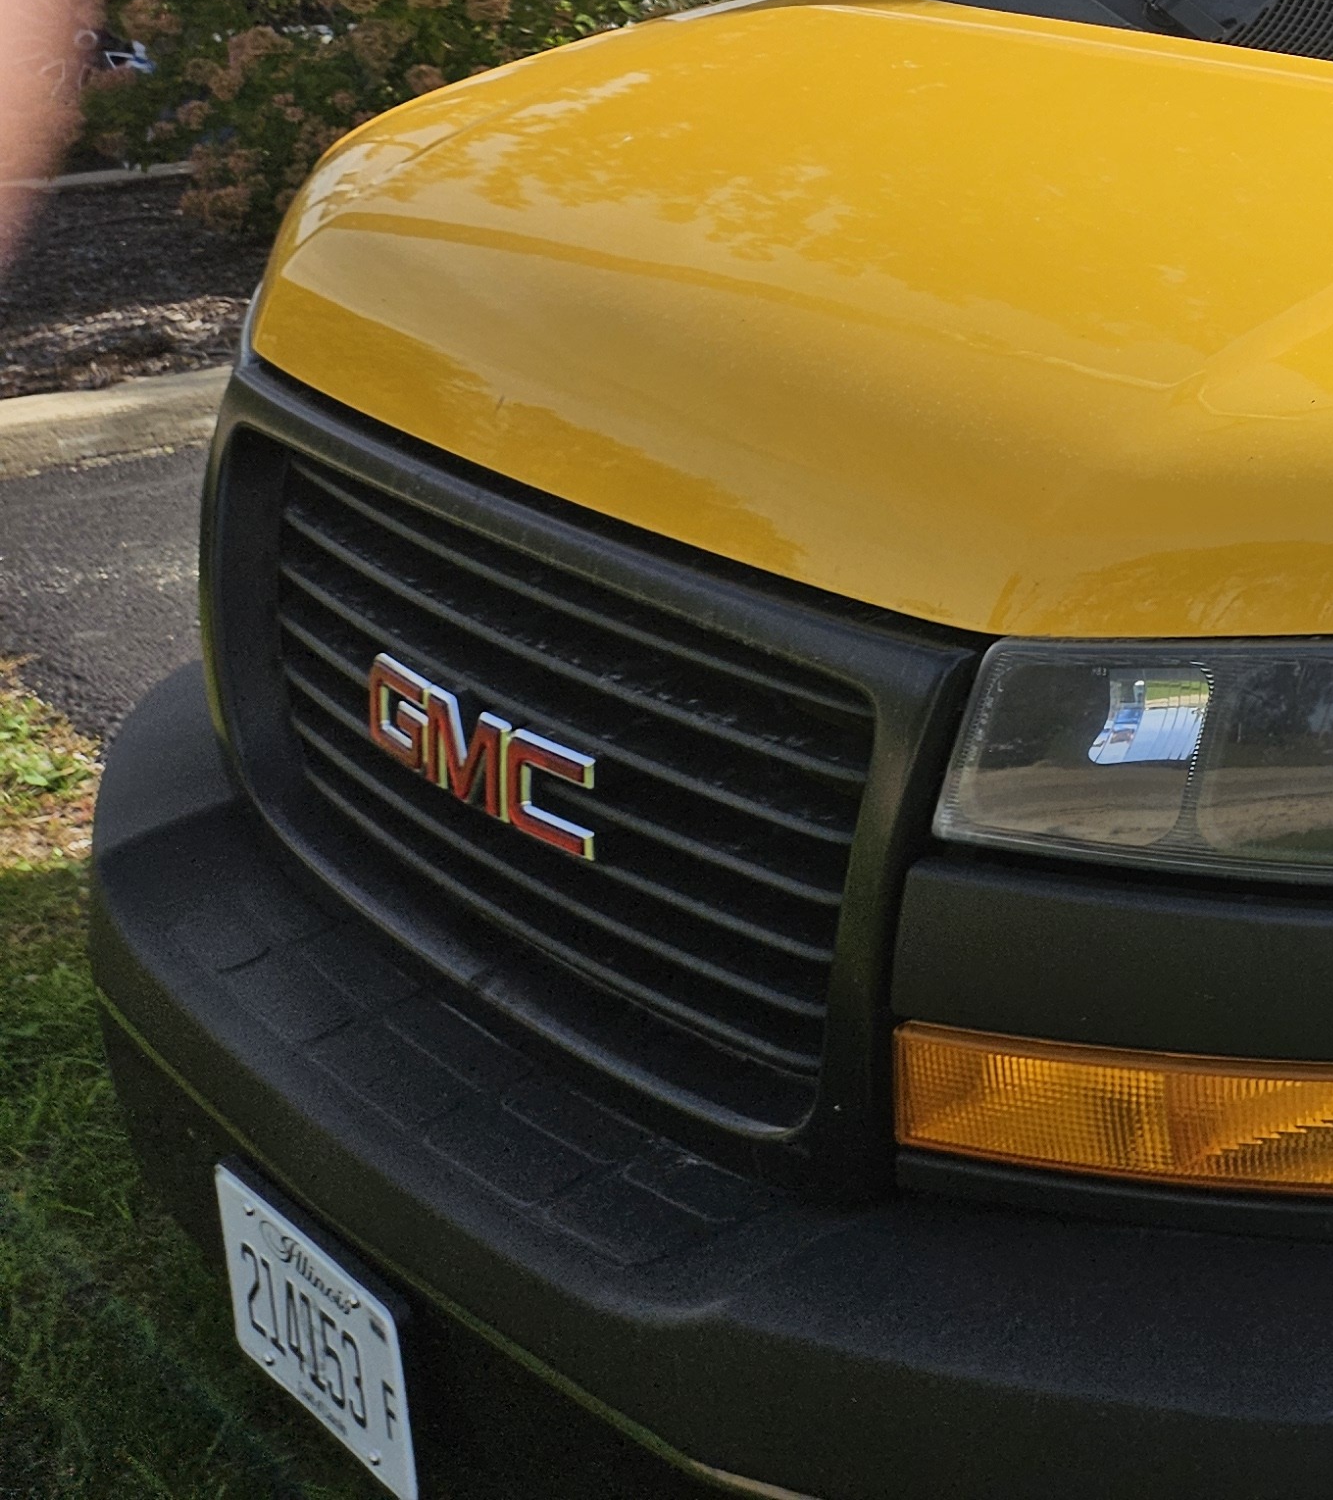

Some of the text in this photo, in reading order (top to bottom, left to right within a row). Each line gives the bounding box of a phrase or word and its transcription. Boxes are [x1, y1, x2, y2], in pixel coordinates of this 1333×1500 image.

[368, 651, 596, 861] GMC
[240, 1241, 368, 1429] 214153
[381, 1379, 398, 1441] F
[259, 1219, 355, 1315] Illinois
